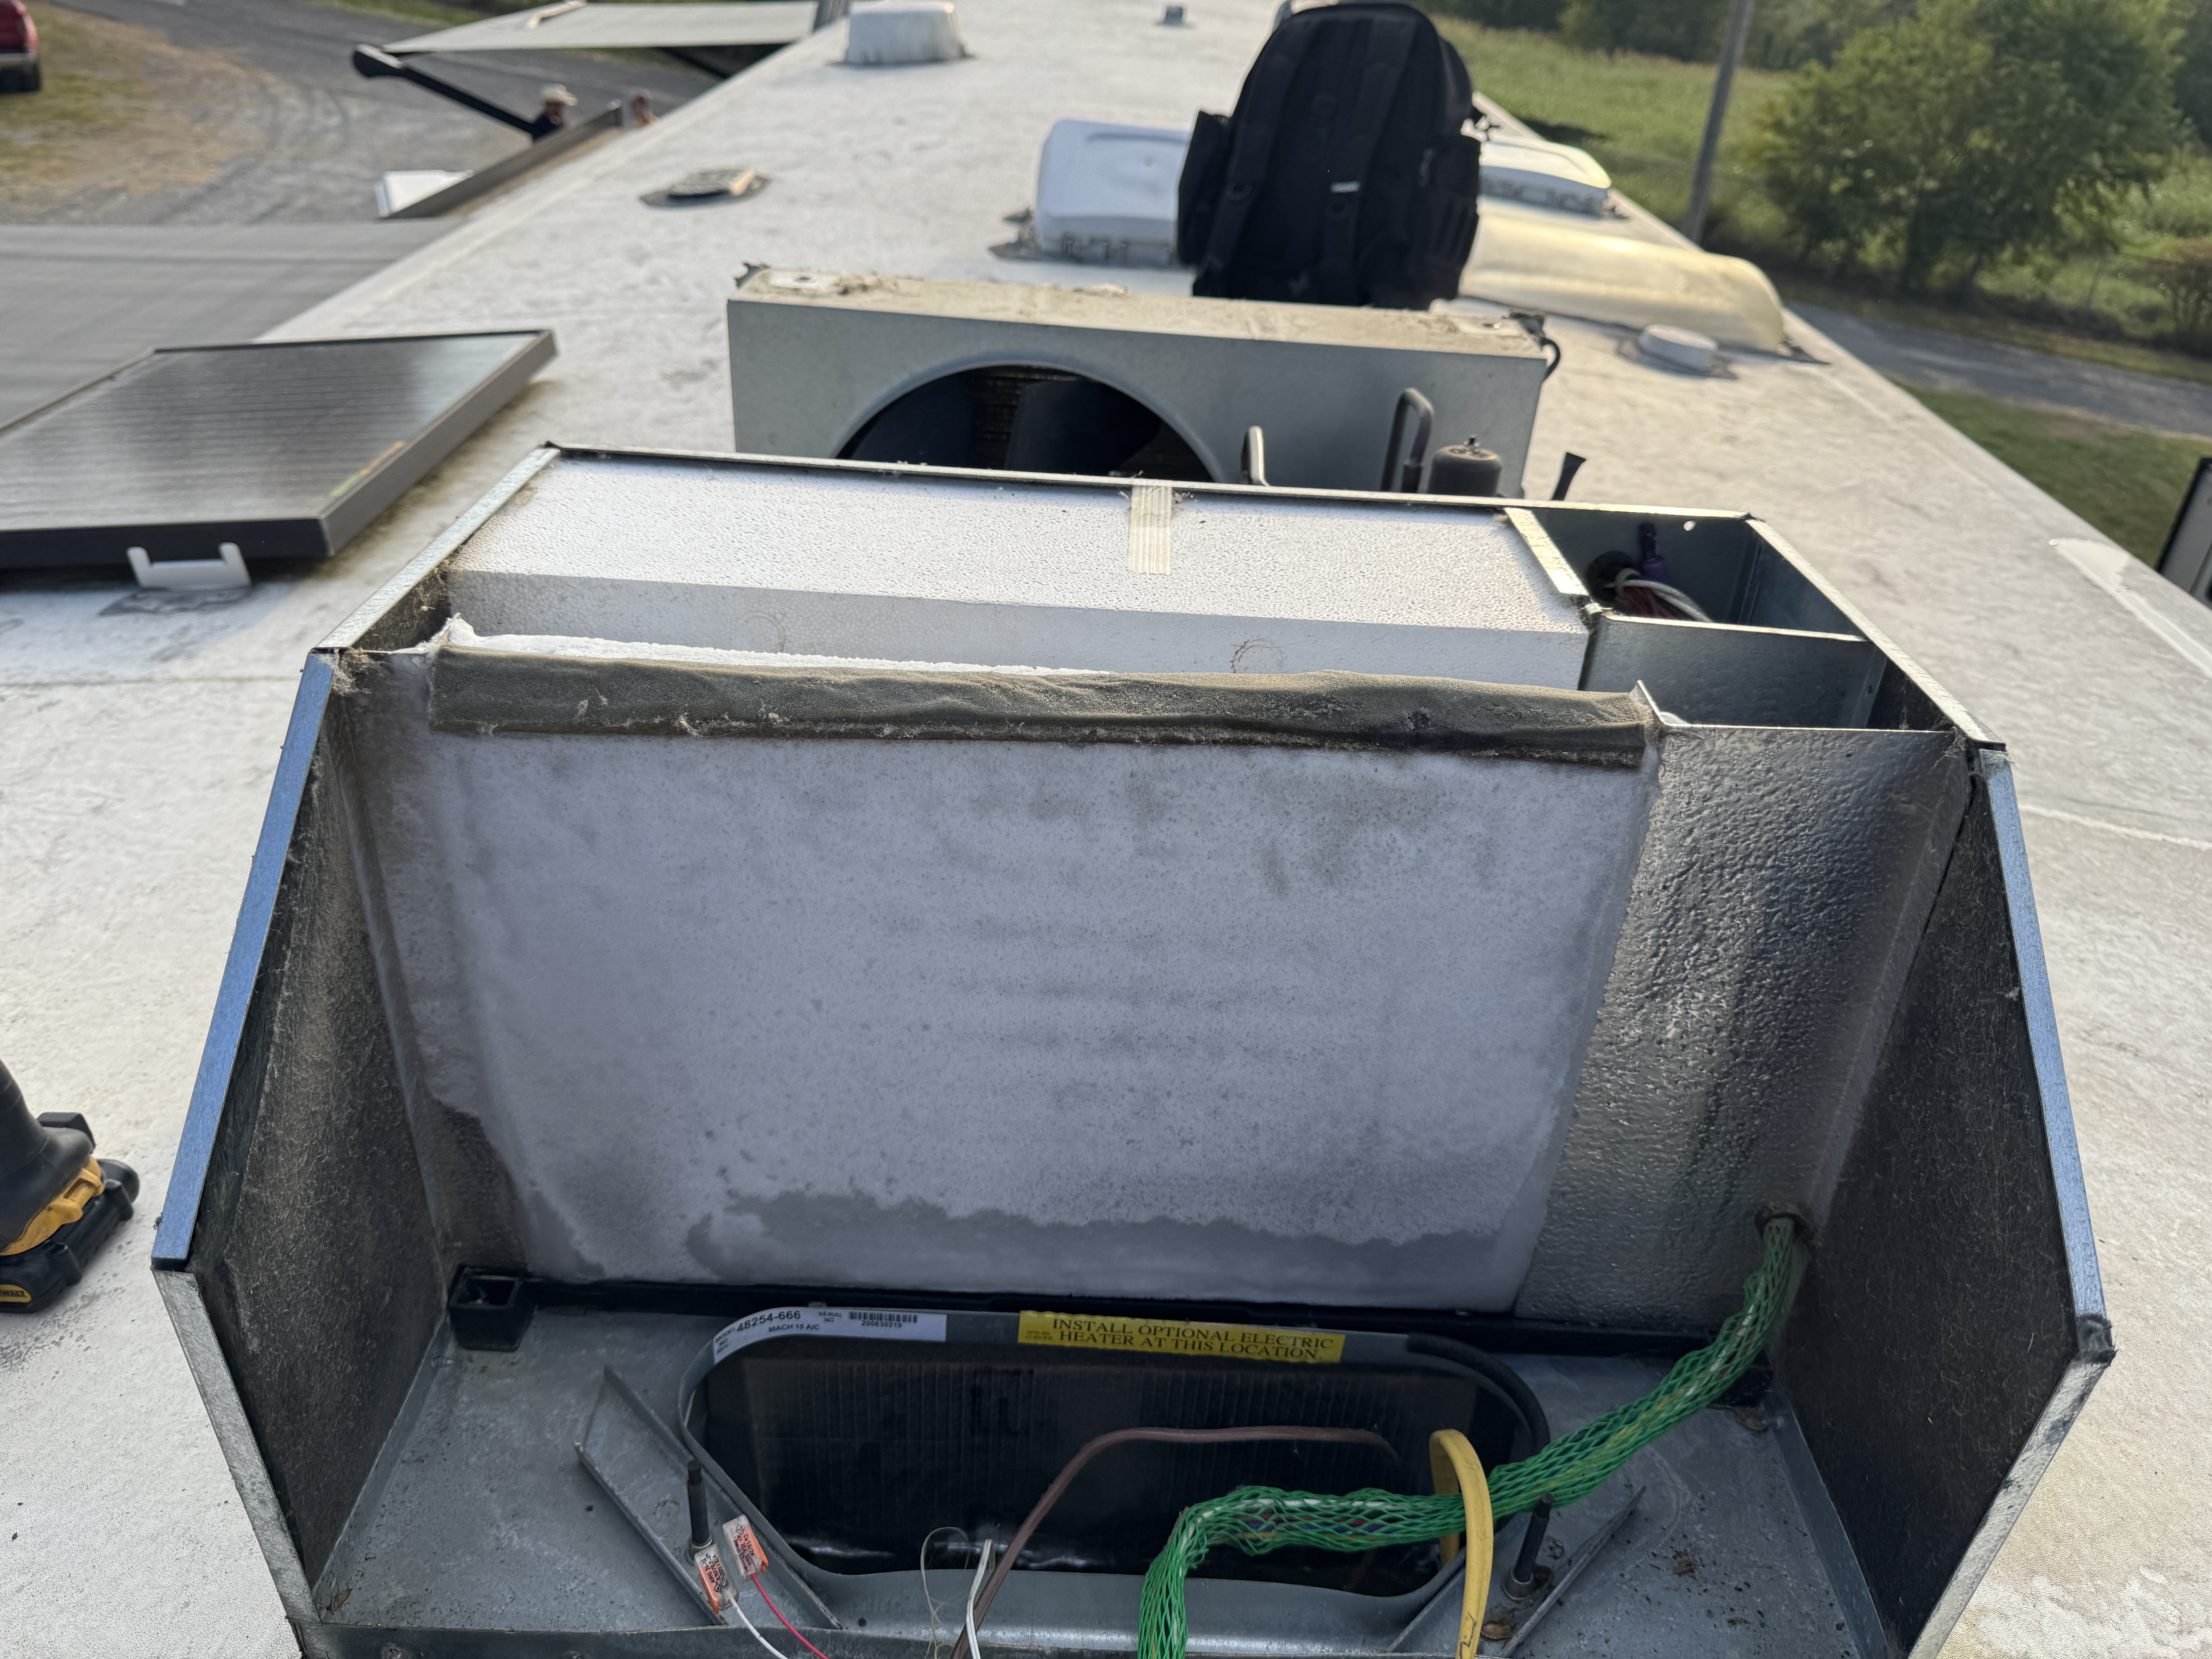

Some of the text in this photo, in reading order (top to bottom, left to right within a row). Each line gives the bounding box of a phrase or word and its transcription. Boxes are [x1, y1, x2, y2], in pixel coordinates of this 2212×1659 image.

[737, 1310, 801, 1331] 48254-666
[769, 1324, 793, 1332] MACH
[1053, 1319, 1333, 1348] INSTALL OPTIONAL ELECTRIC
[1060, 1331, 1134, 1345] HEATER
[1140, 1337, 1165, 1347] AT
[1172, 1338, 1213, 1350] THIS
